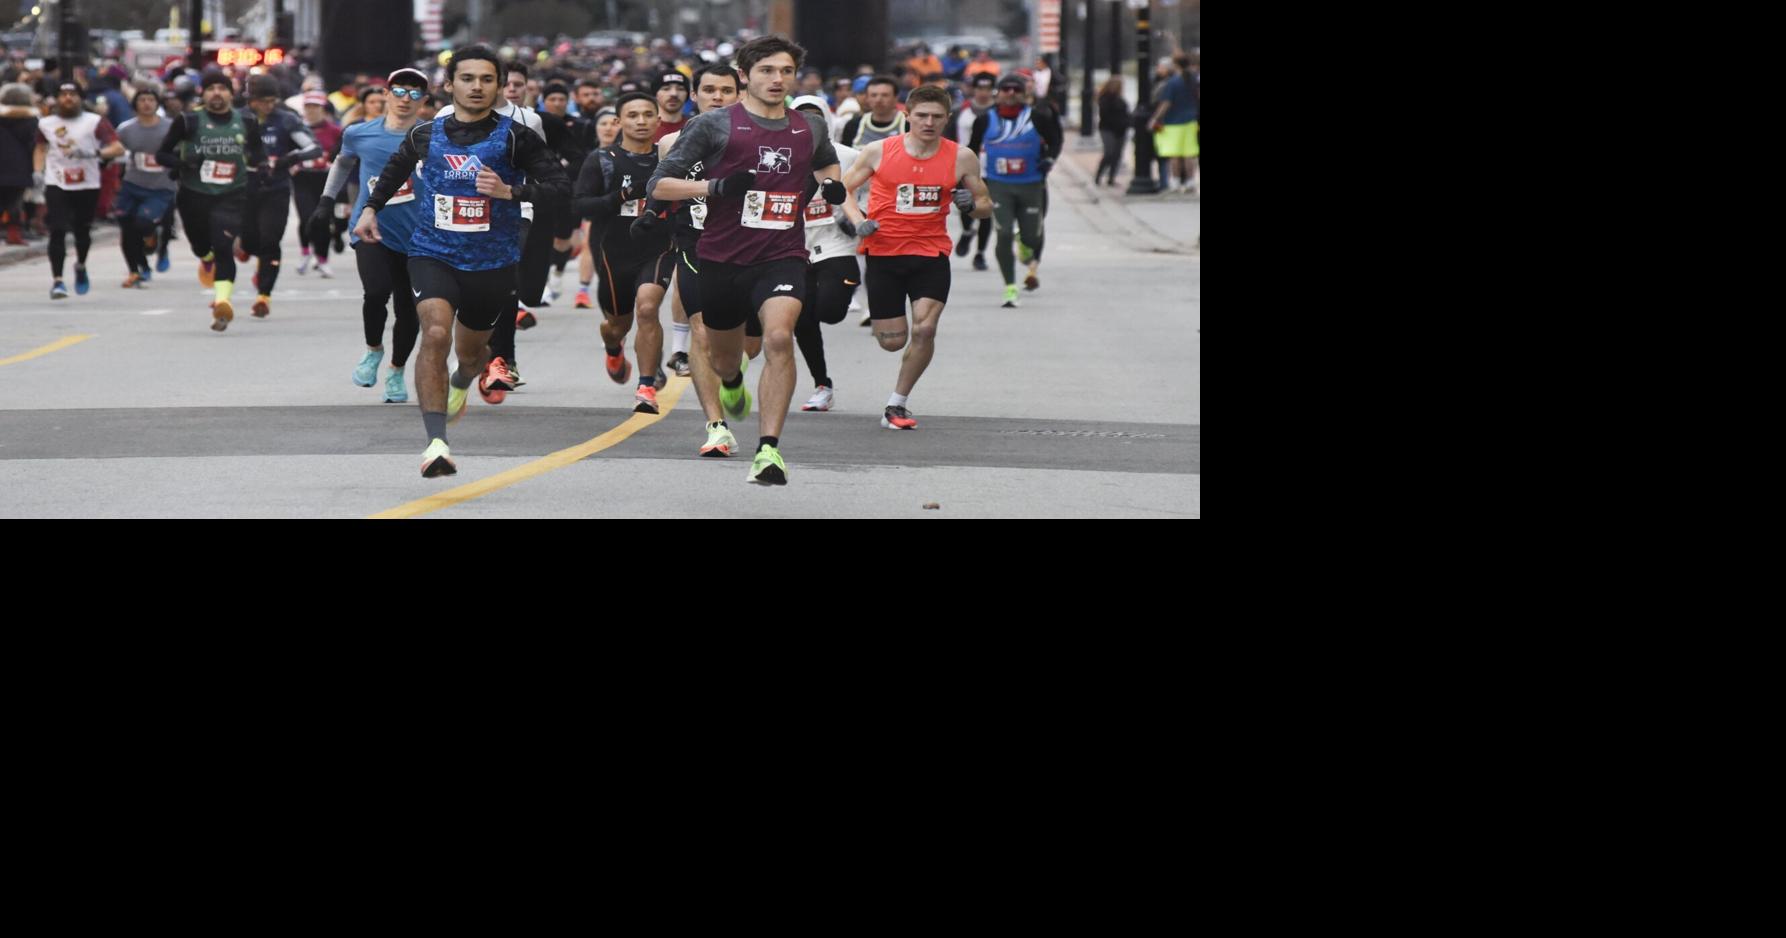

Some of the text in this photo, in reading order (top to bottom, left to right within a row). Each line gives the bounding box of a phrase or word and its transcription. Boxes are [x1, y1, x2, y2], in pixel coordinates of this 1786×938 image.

[918, 192, 938, 201] 344
[459, 207, 484, 217] 406
[770, 203, 792, 214] 479
[809, 206, 827, 215] 473
